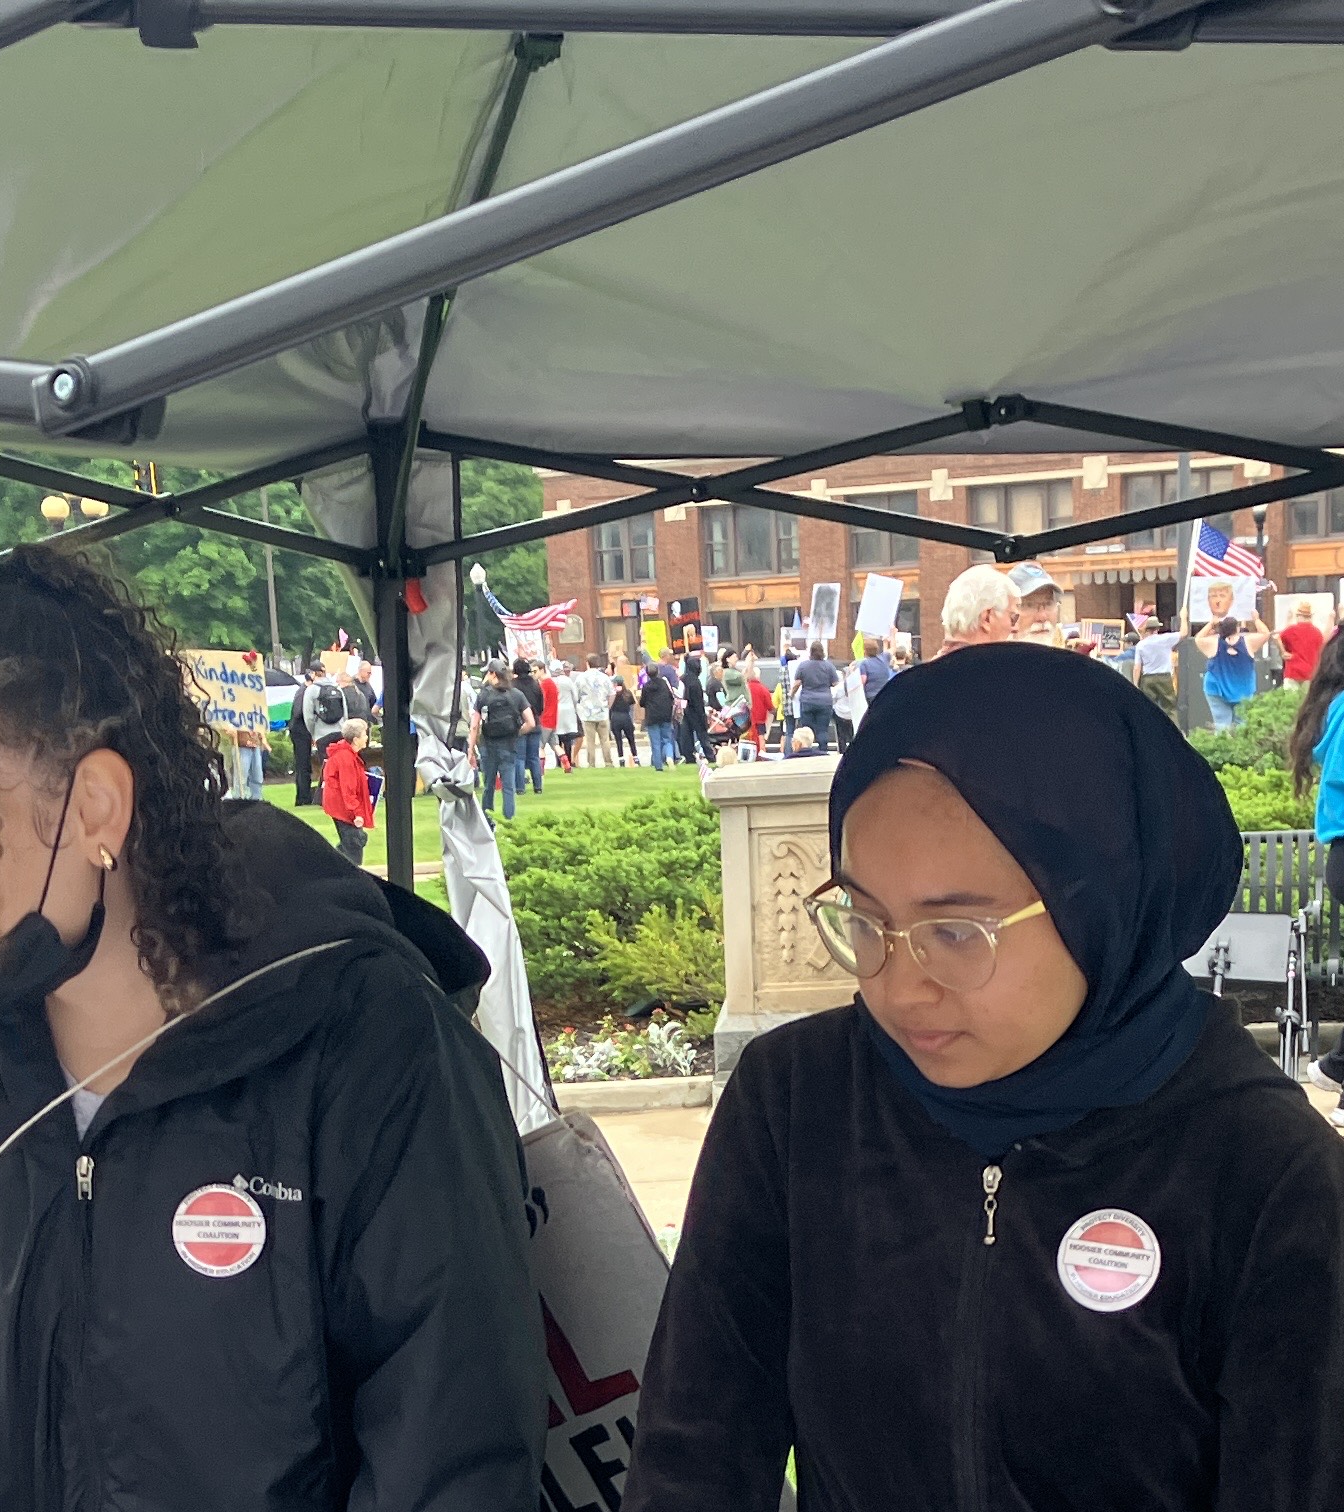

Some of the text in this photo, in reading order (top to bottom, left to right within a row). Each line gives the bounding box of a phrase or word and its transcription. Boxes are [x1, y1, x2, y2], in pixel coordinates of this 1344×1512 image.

[195, 656, 263, 692] Kindness
[220, 686, 235, 702] is
[197, 1231, 240, 1240] COALITION
[1103, 1249, 1151, 1262] COMMUNITY
[1088, 1257, 1129, 1270] COALITION
[542, 1300, 640, 1430] L
